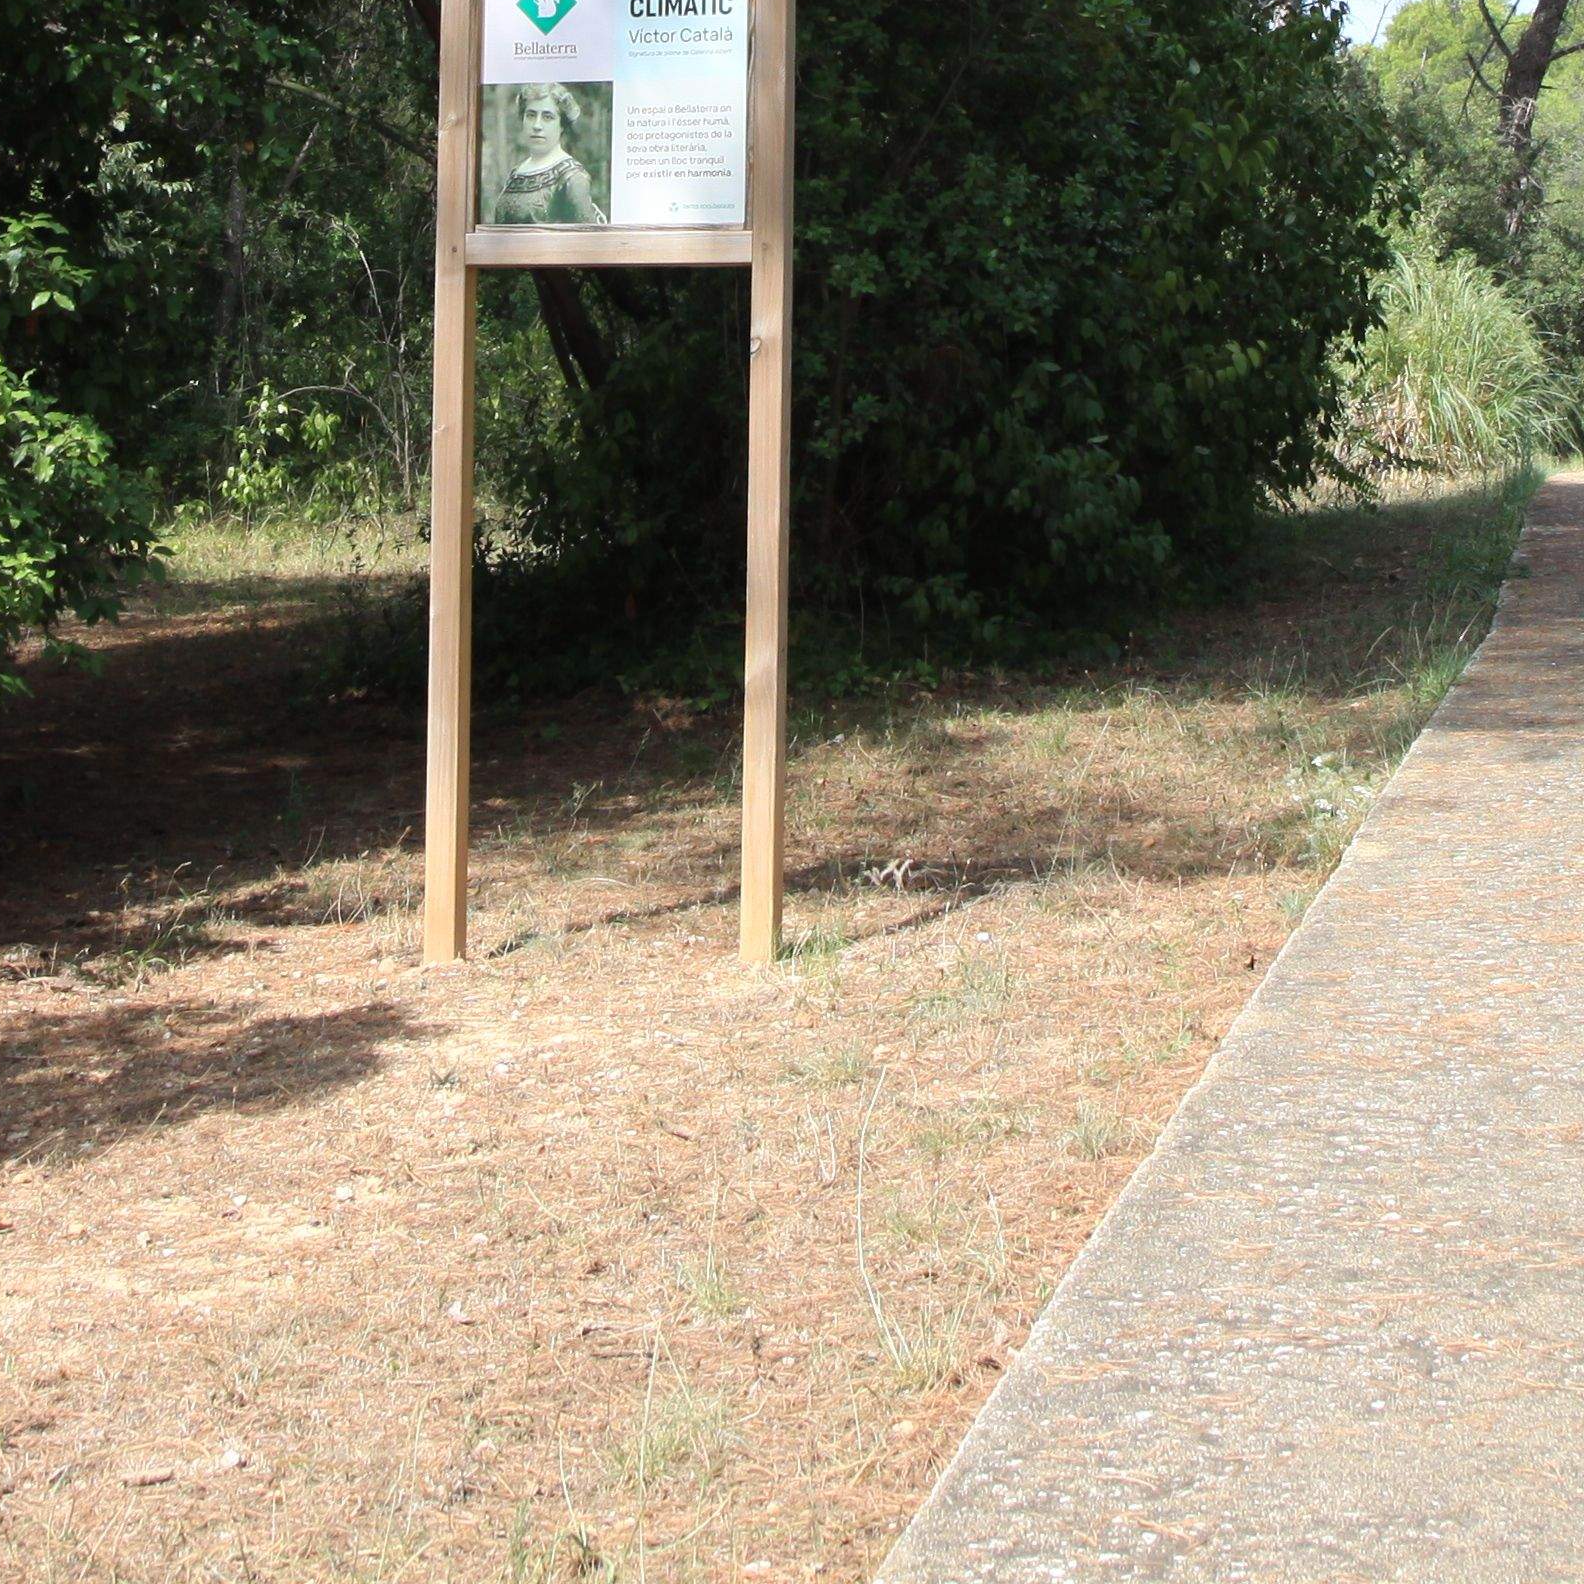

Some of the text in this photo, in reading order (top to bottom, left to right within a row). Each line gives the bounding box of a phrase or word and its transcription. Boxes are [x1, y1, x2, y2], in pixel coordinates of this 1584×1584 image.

[629, 26, 733, 44] Víctor Català
[514, 42, 578, 55] Bellaterra
[627, 106, 640, 115] Un
[674, 105, 718, 114] Bellaterra
[627, 119, 635, 127] la
[636, 119, 666, 127] natura
[645, 131, 709, 141] protagonistes
[711, 130, 722, 139] de
[724, 130, 732, 138] la
[649, 144, 669, 152] obra
[671, 156, 687, 165] lloc
[674, 170, 686, 178] en
